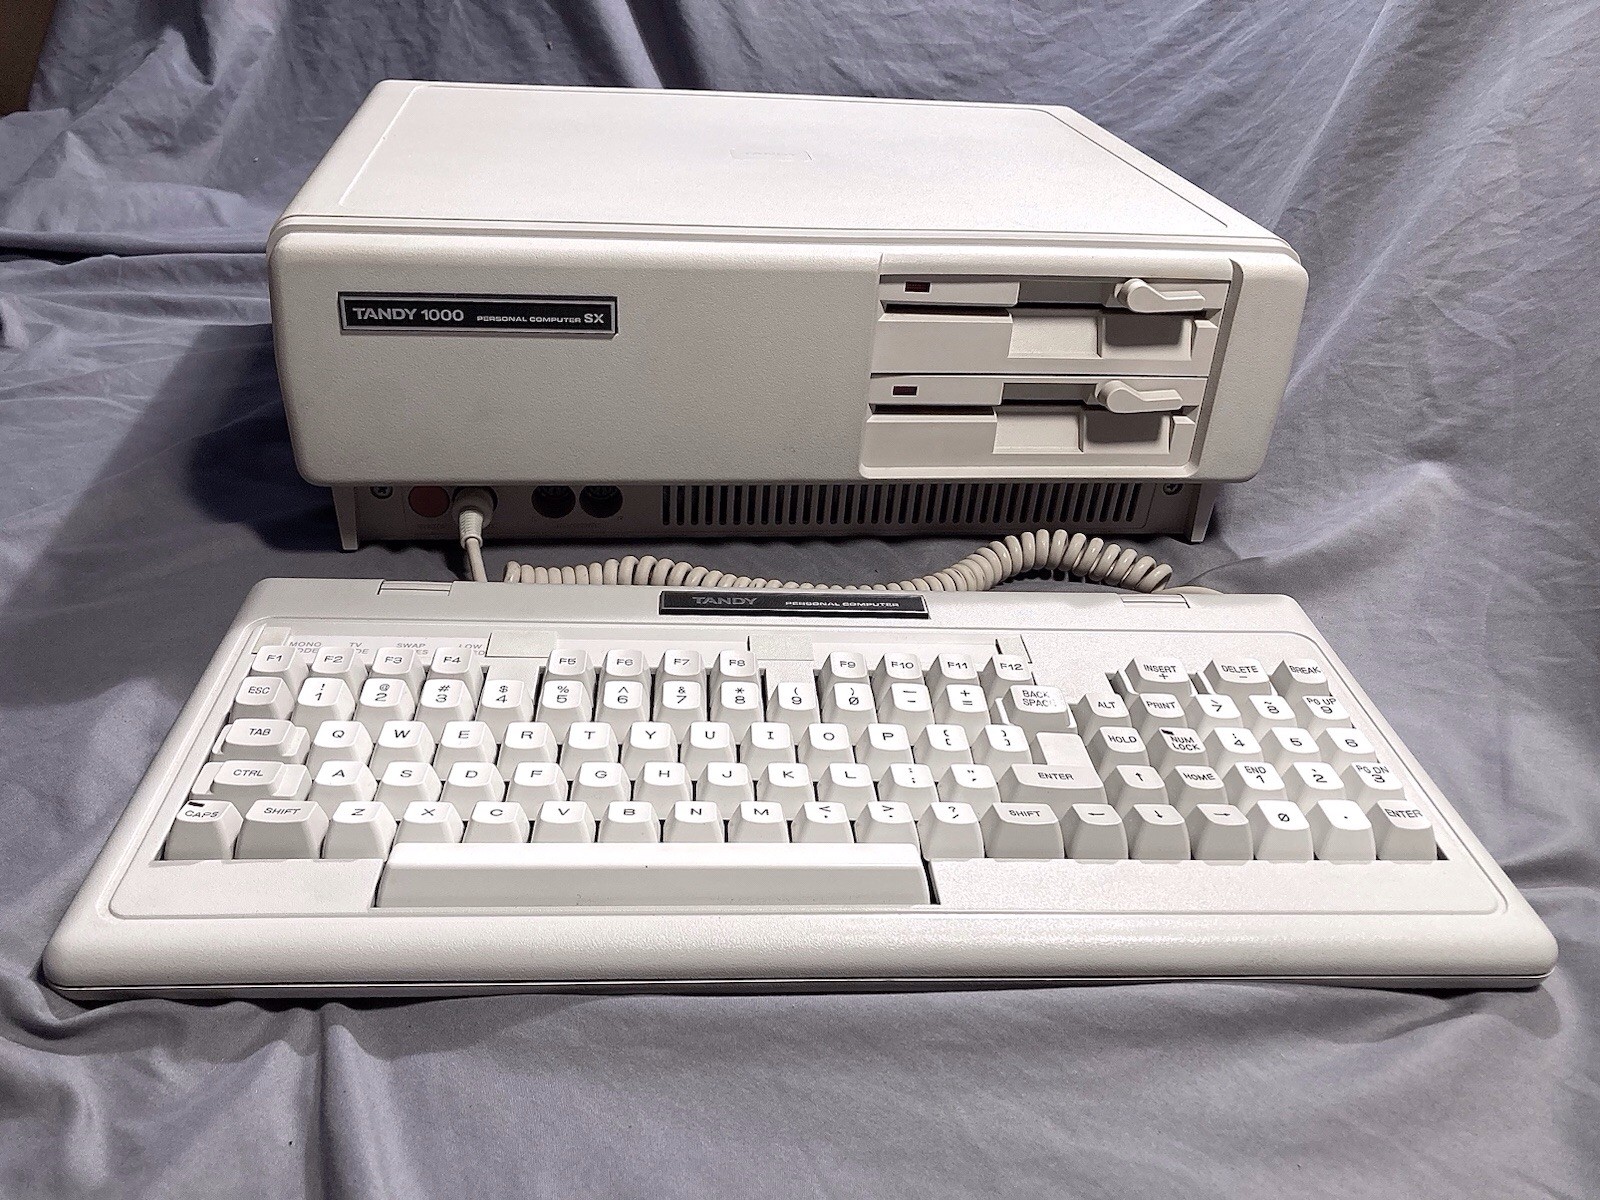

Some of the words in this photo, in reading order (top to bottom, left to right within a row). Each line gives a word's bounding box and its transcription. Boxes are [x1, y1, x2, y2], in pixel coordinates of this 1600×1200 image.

[352, 307, 417, 320] TANDY
[420, 309, 464, 321] 1000
[477, 315, 527, 323] PERSONAL
[584, 313, 604, 324] SX
[692, 596, 757, 605] TANDY
[265, 654, 282, 662] F1
[323, 655, 343, 663] F2
[384, 656, 402, 664] F3
[443, 656, 462, 664] F4
[617, 658, 633, 666] F6
[729, 659, 746, 667] F8
[891, 661, 914, 670] F10
[947, 661, 968, 670] F11
[1000, 663, 1023, 671] F12
[1143, 664, 1176, 673] INSERT
[1221, 664, 1259, 674] DELETE
[1290, 666, 1321, 675] BREAK
[248, 686, 271, 695] ESC
[1022, 690, 1050, 698] BACK
[314, 692, 322, 701] 1
[375, 693, 387, 702] 2
[436, 694, 447, 702] 3
[496, 695, 508, 703] 4
[557, 695, 568, 703] 5
[618, 695, 628, 703] 6
[735, 696, 745, 704] 8
[792, 697, 802, 705] 9
[848, 697, 859, 706] 0
[1023, 699, 1056, 707] SPAC
[1098, 701, 1116, 709] ALT
[1146, 701, 1176, 709] PRINT
[1268, 705, 1280, 714] 8
[1321, 705, 1333, 714] 9
[249, 728, 271, 736] TAB
[332, 730, 345, 739] Q
[394, 730, 411, 738] W
[458, 730, 470, 739] E
[521, 731, 533, 739] R
[584, 731, 596, 739] T
[645, 731, 656, 739] Y
[705, 731, 716, 739] U
[767, 731, 774, 739] I
[883, 732, 894, 740] P
[823, 732, 835, 741] O
[1107, 735, 1137, 743] HOLD
[1170, 736, 1194, 744] NUM
[1290, 738, 1302, 746] 5
[1345, 739, 1358, 747] 6
[233, 769, 263, 777] CTRL
[1244, 765, 1266, 774] END
[1374, 765, 1389, 774] DN
[332, 770, 345, 778] A
[400, 770, 412, 778] S
[659, 770, 670, 778] H
[1038, 772, 1074, 780] ENTER
[1184, 772, 1215, 781] HOME
[1313, 773, 1327, 783] 2
[1256, 775, 1264, 783] 1
[1372, 774, 1385, 783] 3
[184, 810, 219, 818] CAPS
[558, 808, 570, 816] V
[1009, 809, 1041, 818] SHIFT
[1385, 809, 1423, 818] ENTER
[1278, 813, 1289, 822] 0
